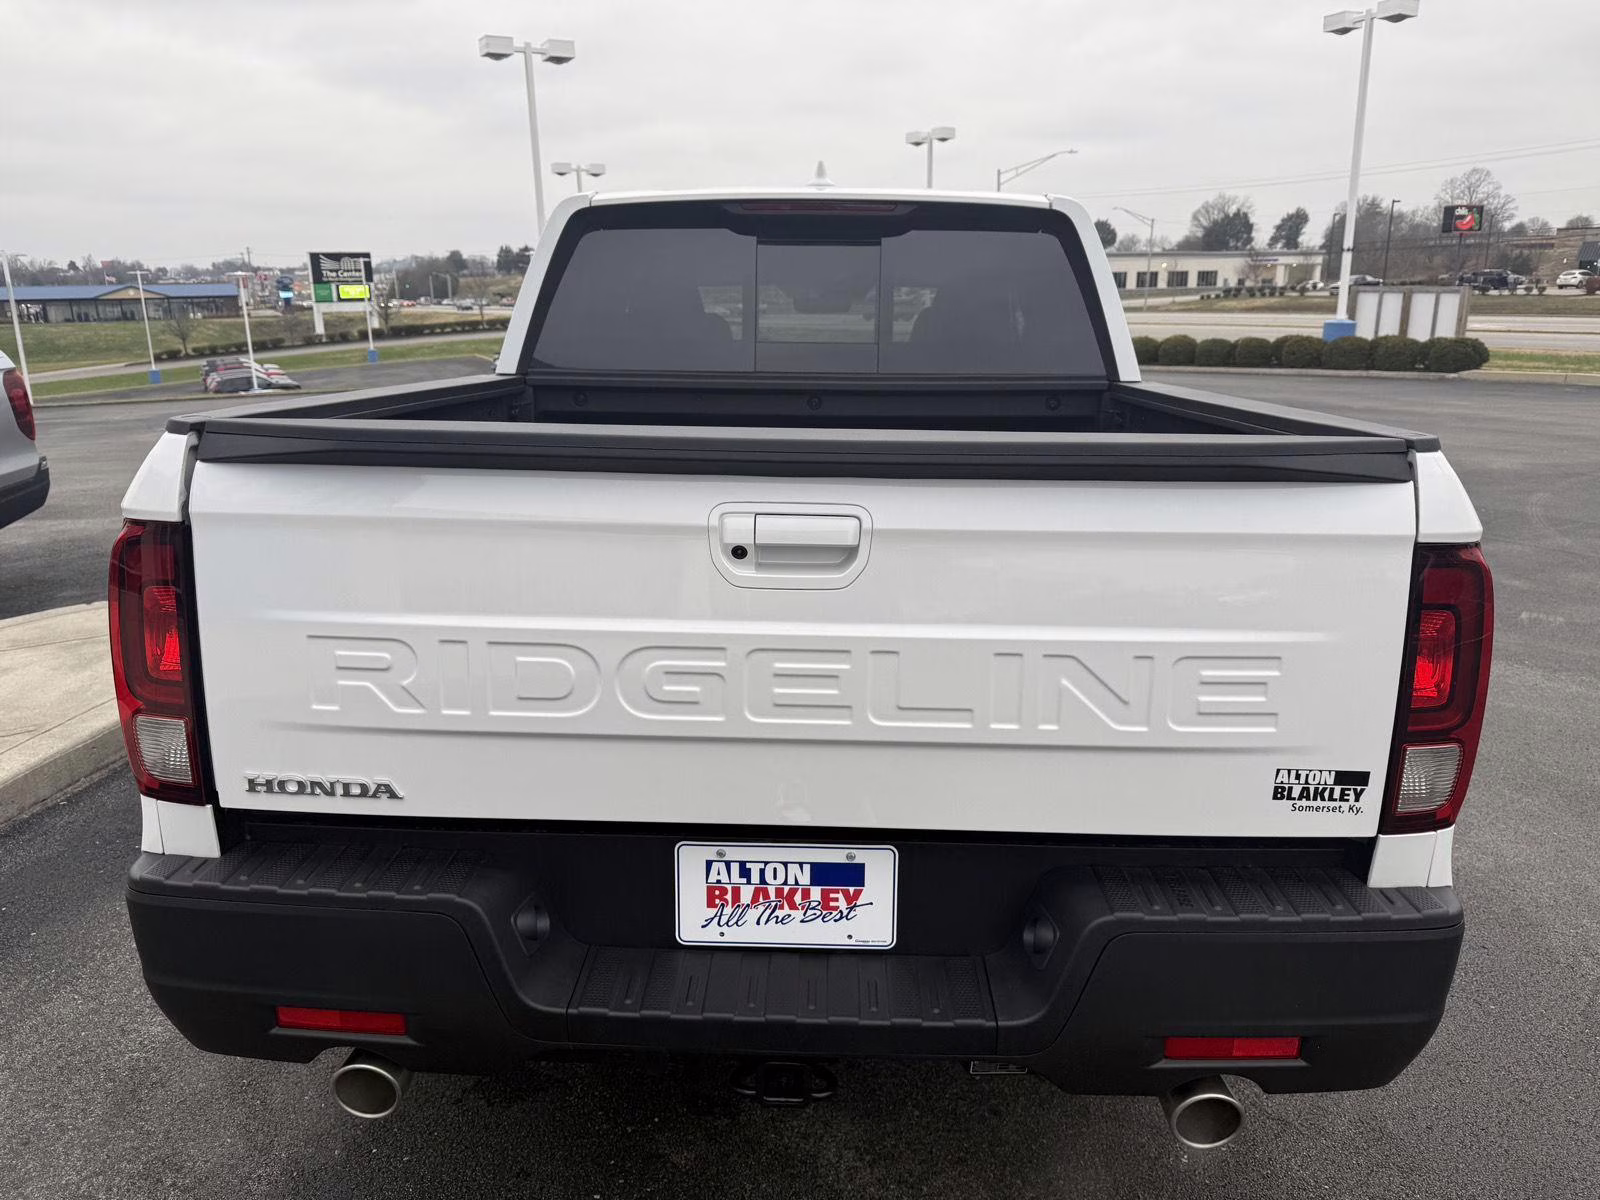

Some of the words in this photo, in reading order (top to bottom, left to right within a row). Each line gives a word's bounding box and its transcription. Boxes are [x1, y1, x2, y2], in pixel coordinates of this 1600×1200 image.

[306, 635, 1282, 732] RIDGELINE
[245, 772, 404, 799] HONDA
[1275, 769, 1335, 785] ALTON
[1272, 786, 1366, 802] BLAKLEY
[1291, 803, 1344, 814] Somerset,
[1348, 804, 1363, 815] Ky.
[707, 861, 811, 885] ALTON
[706, 885, 864, 912] BLAKLEY
[701, 902, 750, 928] All
[754, 899, 794, 926] The
[798, 900, 873, 924] Best
